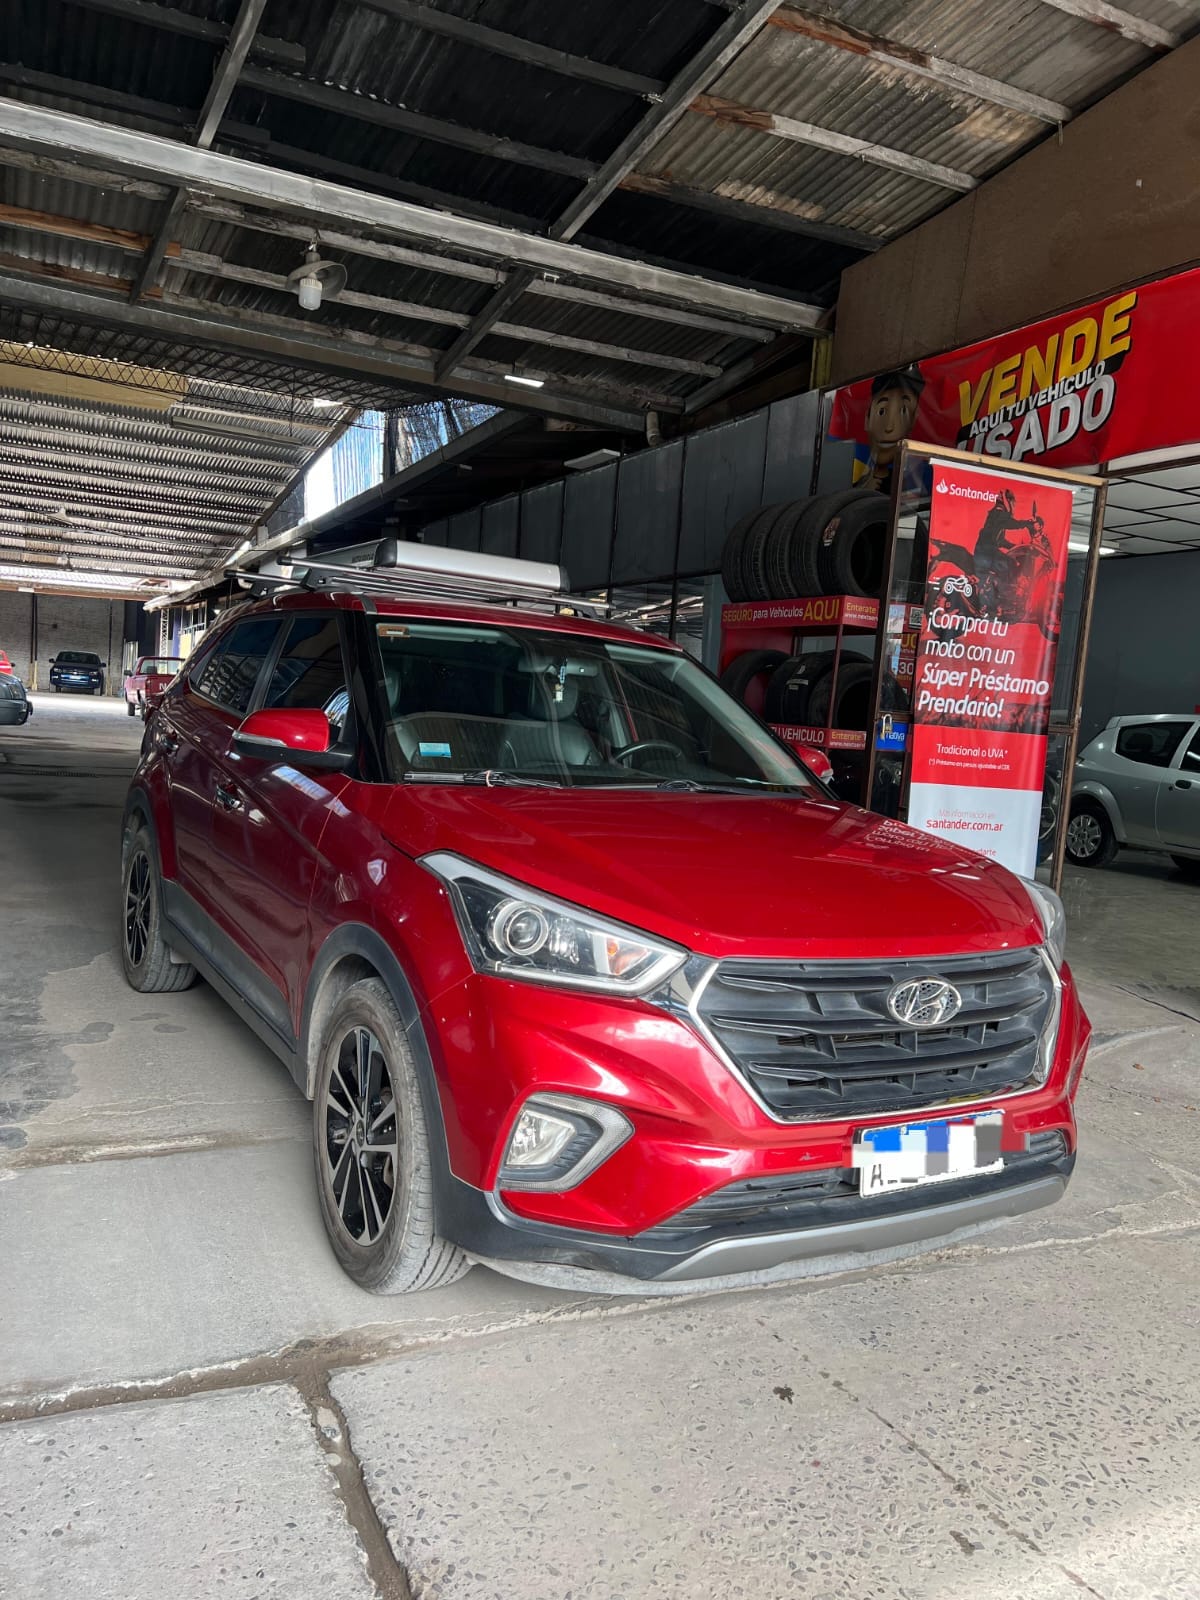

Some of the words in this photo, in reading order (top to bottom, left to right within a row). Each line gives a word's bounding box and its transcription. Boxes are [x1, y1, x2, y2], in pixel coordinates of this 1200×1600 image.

[958, 291, 1137, 427] VENDE
[969, 404, 1004, 438] AQUÍ
[1007, 400, 1025, 421] TU
[1028, 360, 1106, 411] VEHÍCULO
[949, 483, 999, 503] Santander
[722, 608, 752, 622] SEGURO
[752, 610, 768, 622] para
[803, 599, 839, 621] AQUI
[846, 602, 877, 614] Enterate
[927, 607, 989, 636] ¡Comprá
[992, 617, 1008, 637] tu
[925, 639, 965, 660] moto
[967, 646, 991, 663] con
[995, 648, 1015, 665] un
[921, 662, 968, 690] Súper
[969, 668, 1049, 695] Préstamo
[918, 690, 1004, 719] Prendario!
[782, 727, 825, 743] VEHICULO
[936, 743, 979, 758] Tradicional
[926, 818, 1004, 832] santander.com.ar
